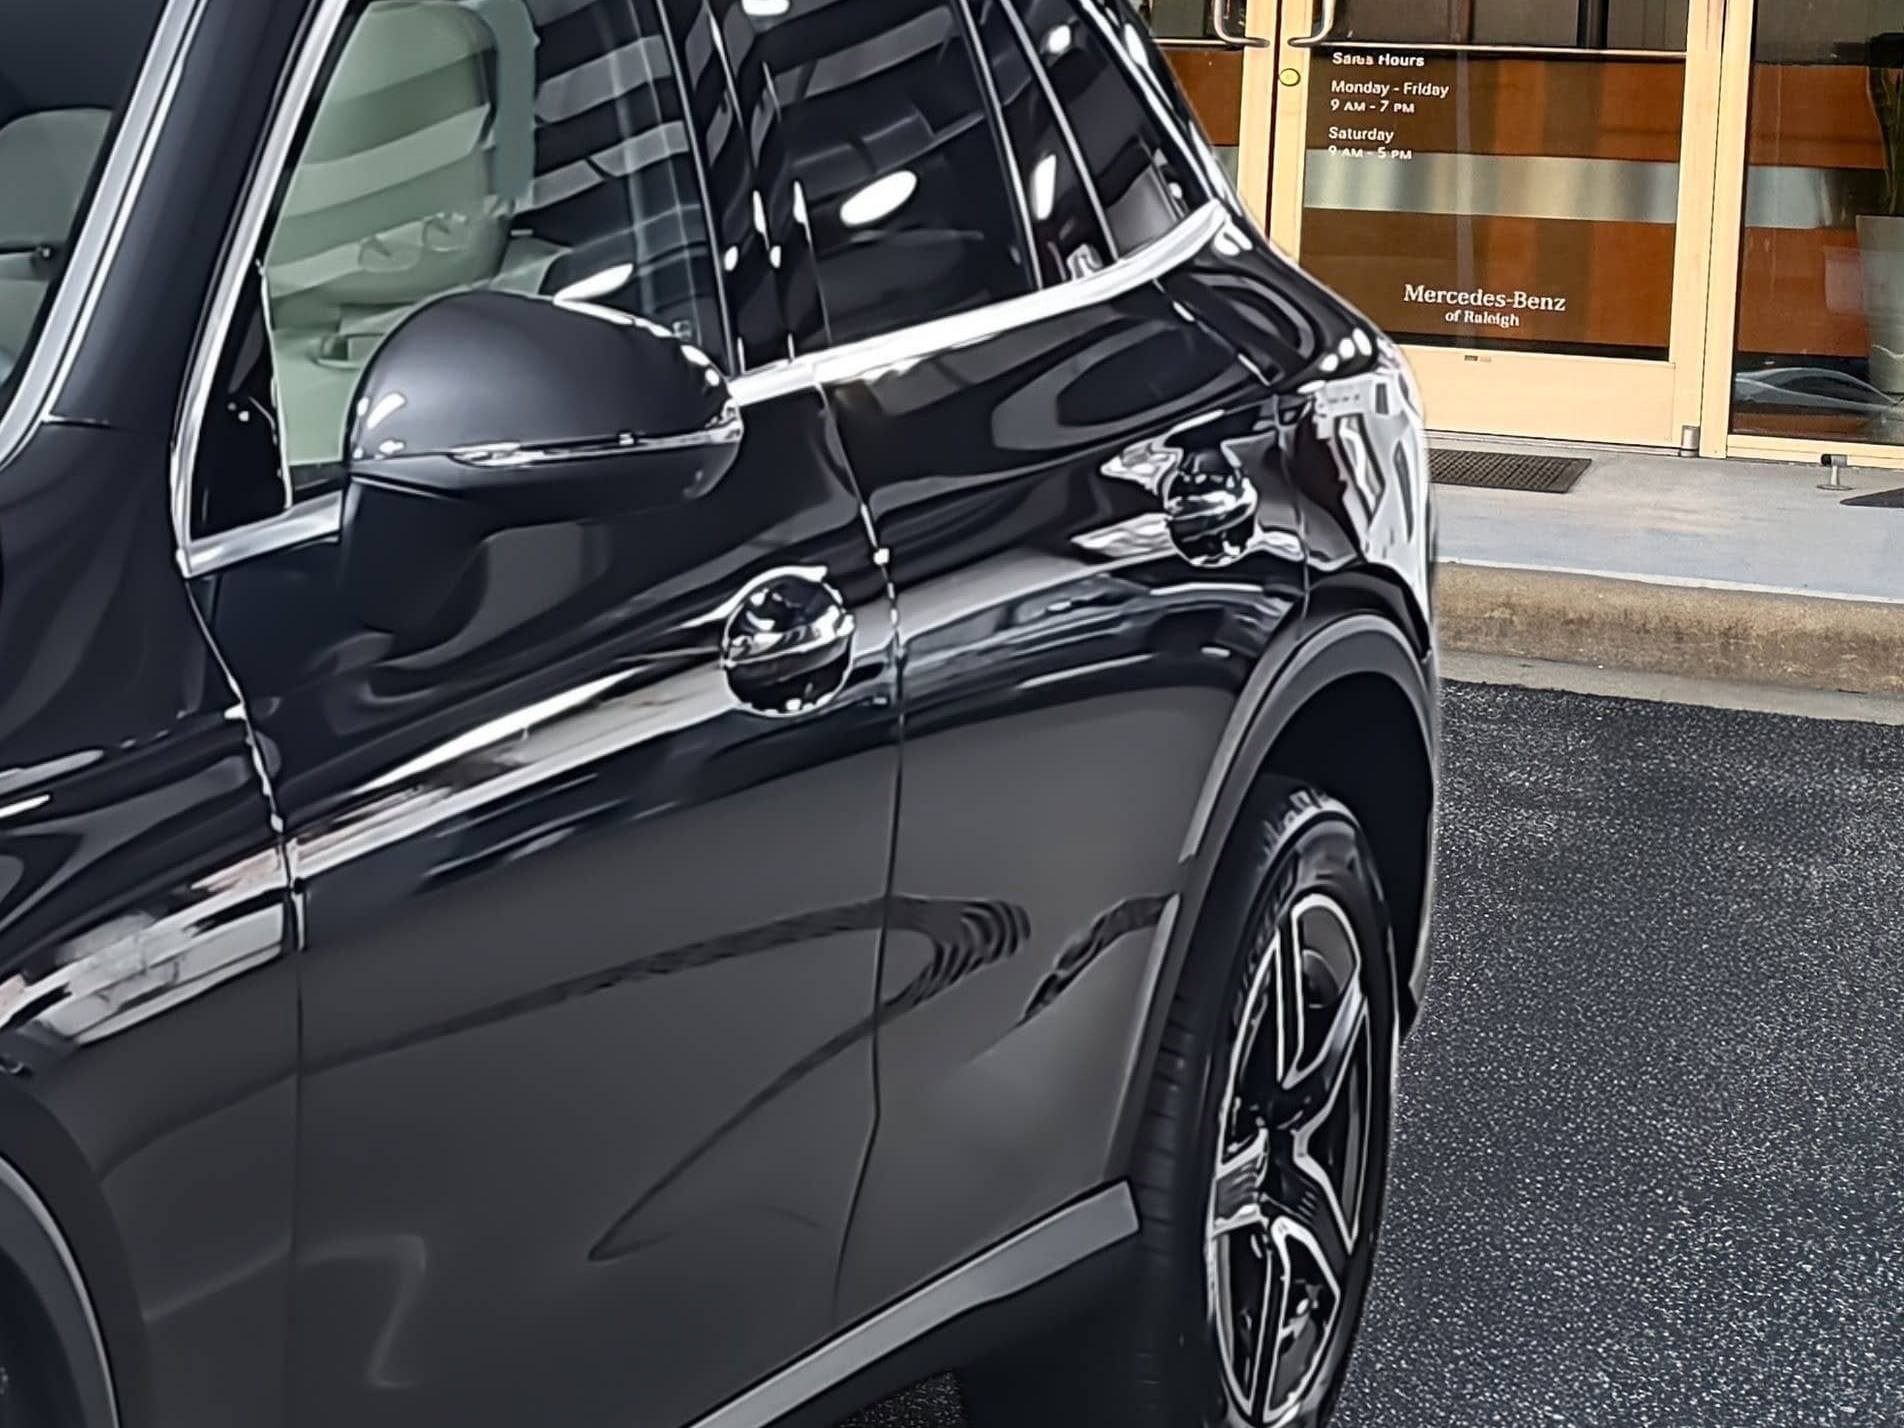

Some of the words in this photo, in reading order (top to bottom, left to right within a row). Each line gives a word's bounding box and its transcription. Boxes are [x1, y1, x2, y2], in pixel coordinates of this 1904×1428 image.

[1377, 53, 1426, 68] Hours
[1330, 79, 1391, 98] Monday
[1402, 81, 1450, 99] Friday
[1329, 98, 1341, 112] 9
[1343, 100, 1367, 113] AM
[1379, 99, 1390, 113] 7
[1393, 102, 1416, 114] PM
[1328, 125, 1395, 145] Saturday
[1328, 144, 1338, 158] 9
[1342, 147, 1364, 159] AM
[1377, 146, 1388, 159] 5
[1391, 149, 1413, 160] PM
[1403, 283, 1567, 312] Mercedes-Benz
[1444, 310, 1462, 323] of
[1464, 311, 1520, 329] Raleigh
